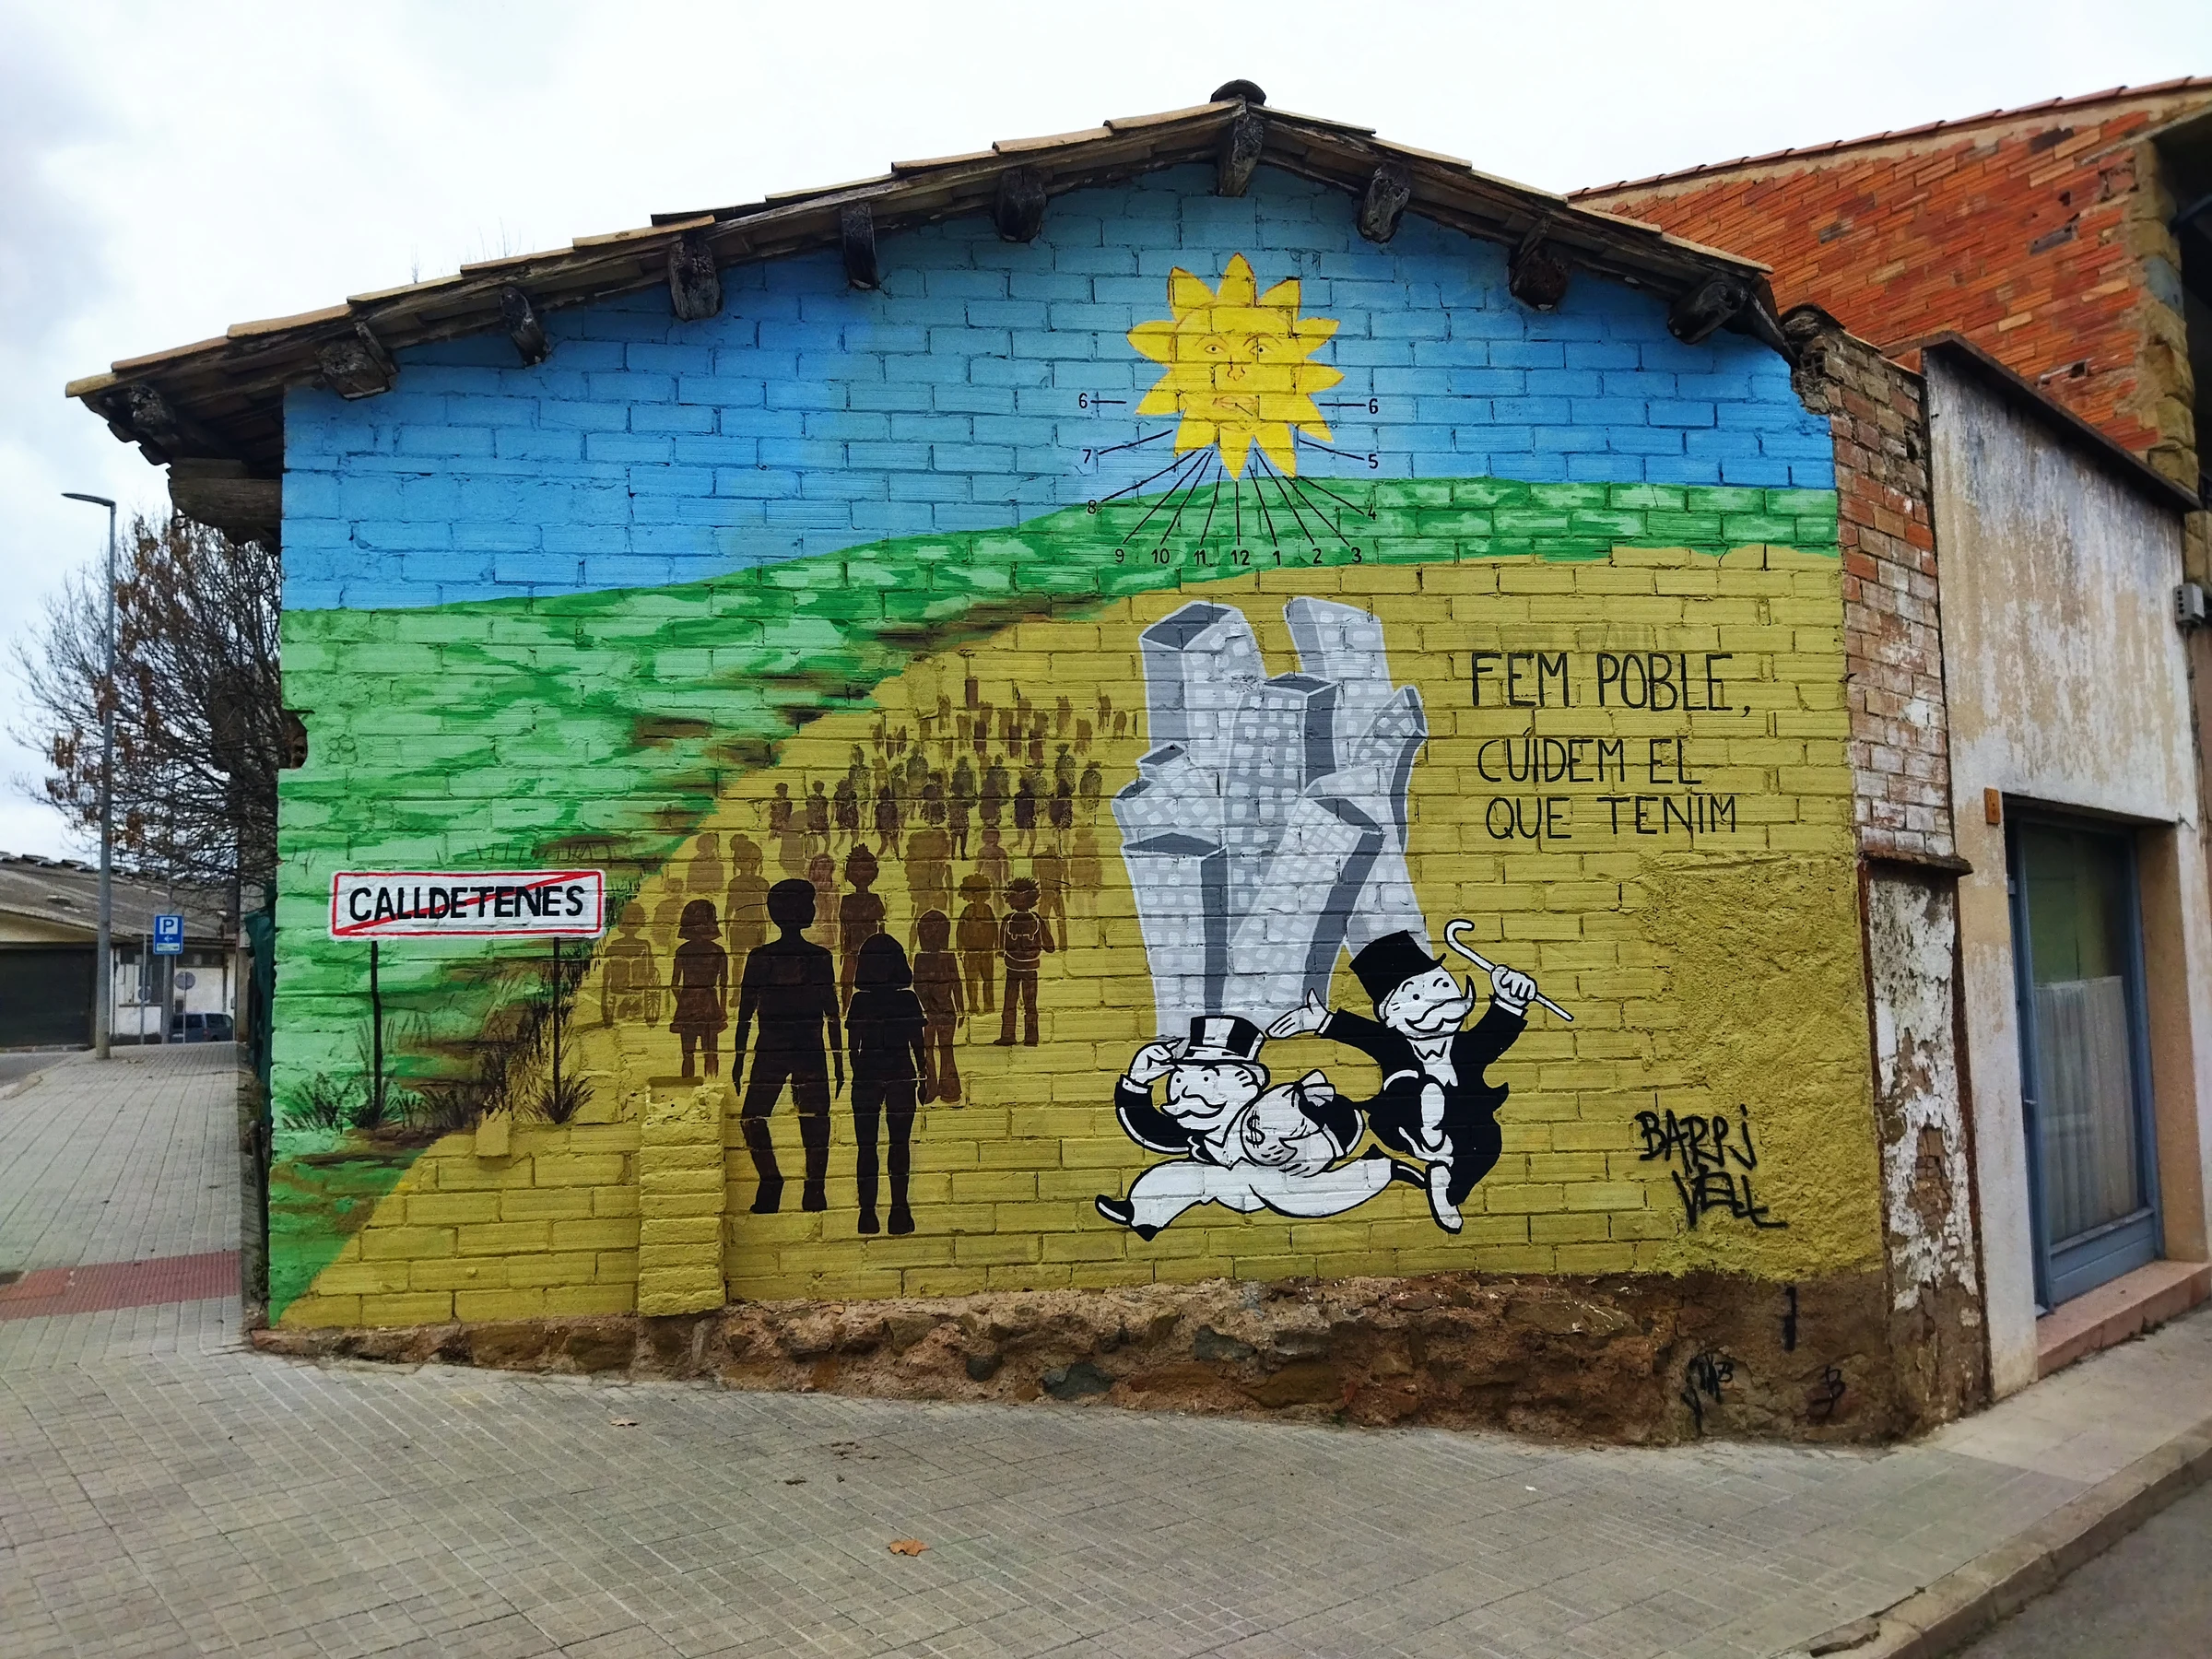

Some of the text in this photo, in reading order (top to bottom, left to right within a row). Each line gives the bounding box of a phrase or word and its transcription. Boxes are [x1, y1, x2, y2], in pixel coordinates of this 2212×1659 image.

[1078, 393, 1088, 408] 6
[1368, 398, 1378, 414] 6
[1082, 449, 1091, 464] 7
[1368, 454, 1379, 469] 5
[1087, 499, 1097, 514] 8
[1367, 504, 1377, 521] 4
[1114, 547, 1362, 566] 9 10 11 12 1 2 3
[1472, 652, 1750, 718] FEM POBLE,
[1649, 738, 1702, 784] EL
[1486, 794, 1735, 840] QUE TENIM
[348, 885, 585, 922] CALLDETENES
[162, 919, 175, 933] P
